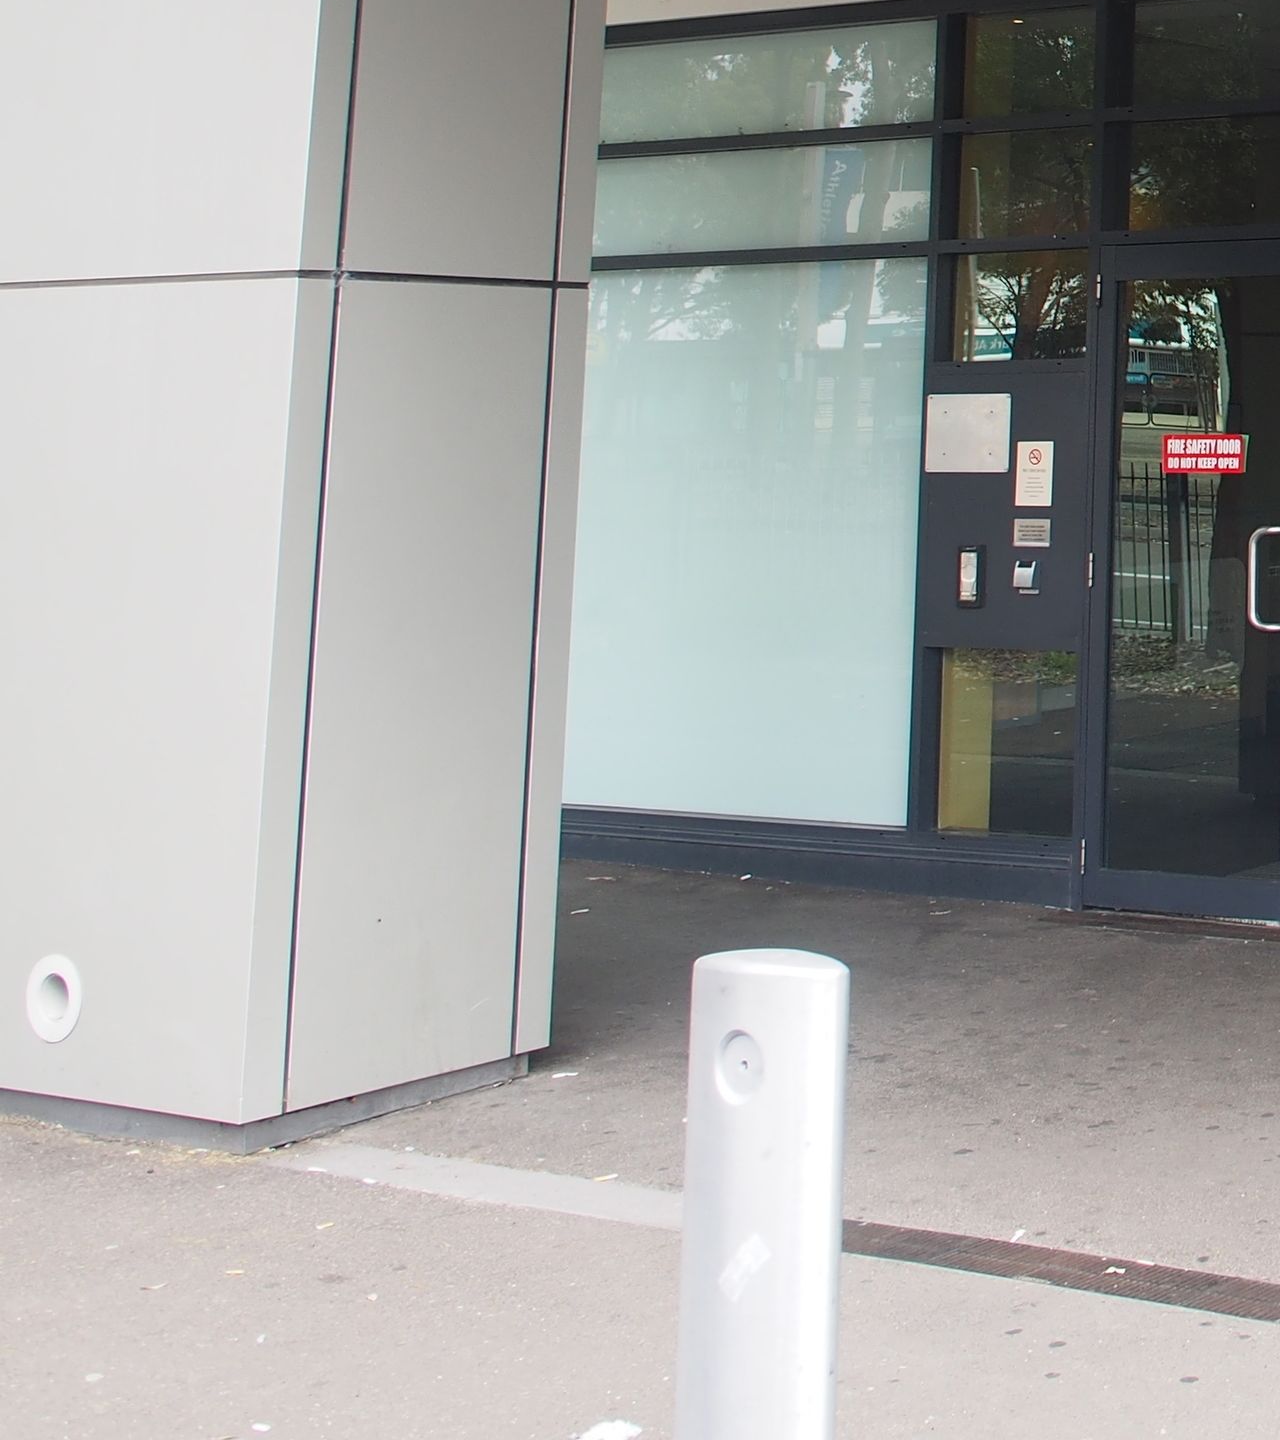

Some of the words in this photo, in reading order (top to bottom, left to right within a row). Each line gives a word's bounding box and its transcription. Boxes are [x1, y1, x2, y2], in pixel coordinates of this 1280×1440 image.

[1167, 438, 1185, 454] FIRE
[1185, 438, 1217, 454] SAFETY
[1216, 438, 1241, 454] DOOR
[1167, 457, 1180, 469] DO
[1180, 457, 1197, 469] NOT
[1197, 457, 1217, 469] KEEP
[1217, 457, 1239, 469] OPEN
